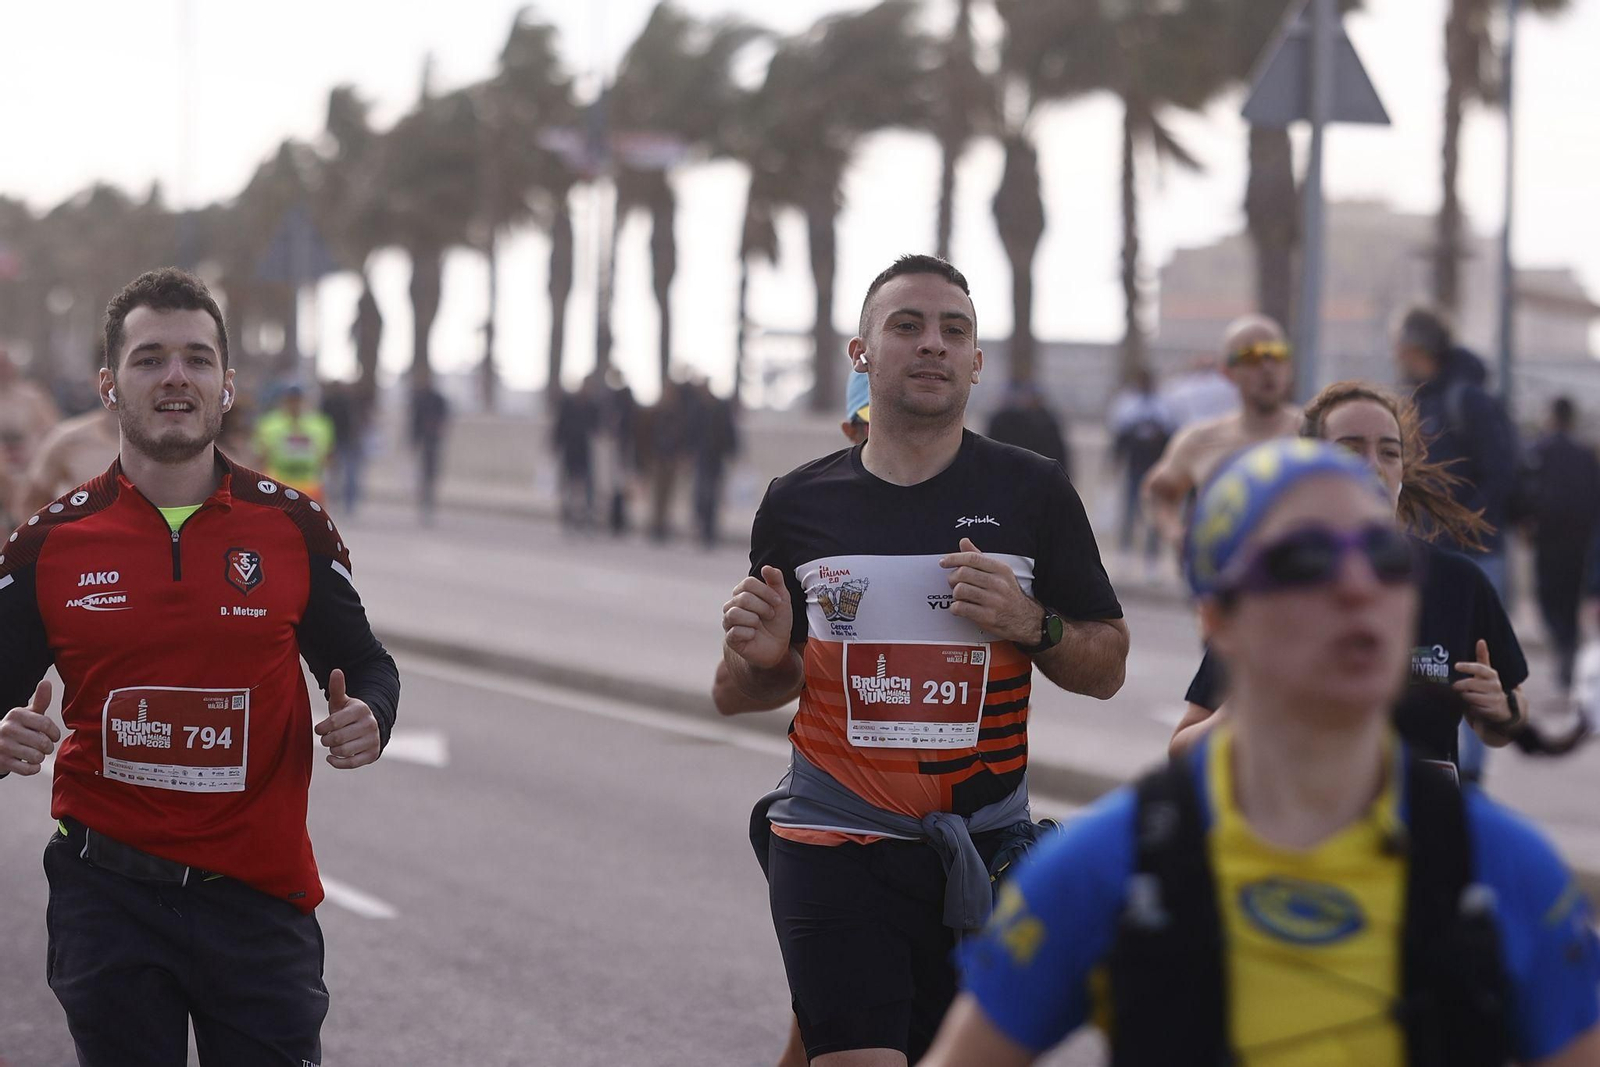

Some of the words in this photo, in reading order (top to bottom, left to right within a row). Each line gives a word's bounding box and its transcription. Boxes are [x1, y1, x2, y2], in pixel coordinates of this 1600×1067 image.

[955, 515, 1000, 528] Spiuk
[78, 571, 119, 586] JAKO
[65, 595, 127, 608] ANSMANN
[927, 601, 956, 610] YU
[220, 606, 230, 616] D.
[233, 606, 267, 618] Metzger
[1412, 663, 1449, 678] HYBRID
[851, 675, 911, 692] BRUNCH
[857, 688, 888, 705] RUN
[922, 680, 969, 705] 291
[885, 696, 911, 705] 2025
[111, 718, 172, 736] BRUNCH
[117, 731, 147, 747] RUN
[146, 740, 171, 749] 2025
[183, 726, 232, 750] 794
